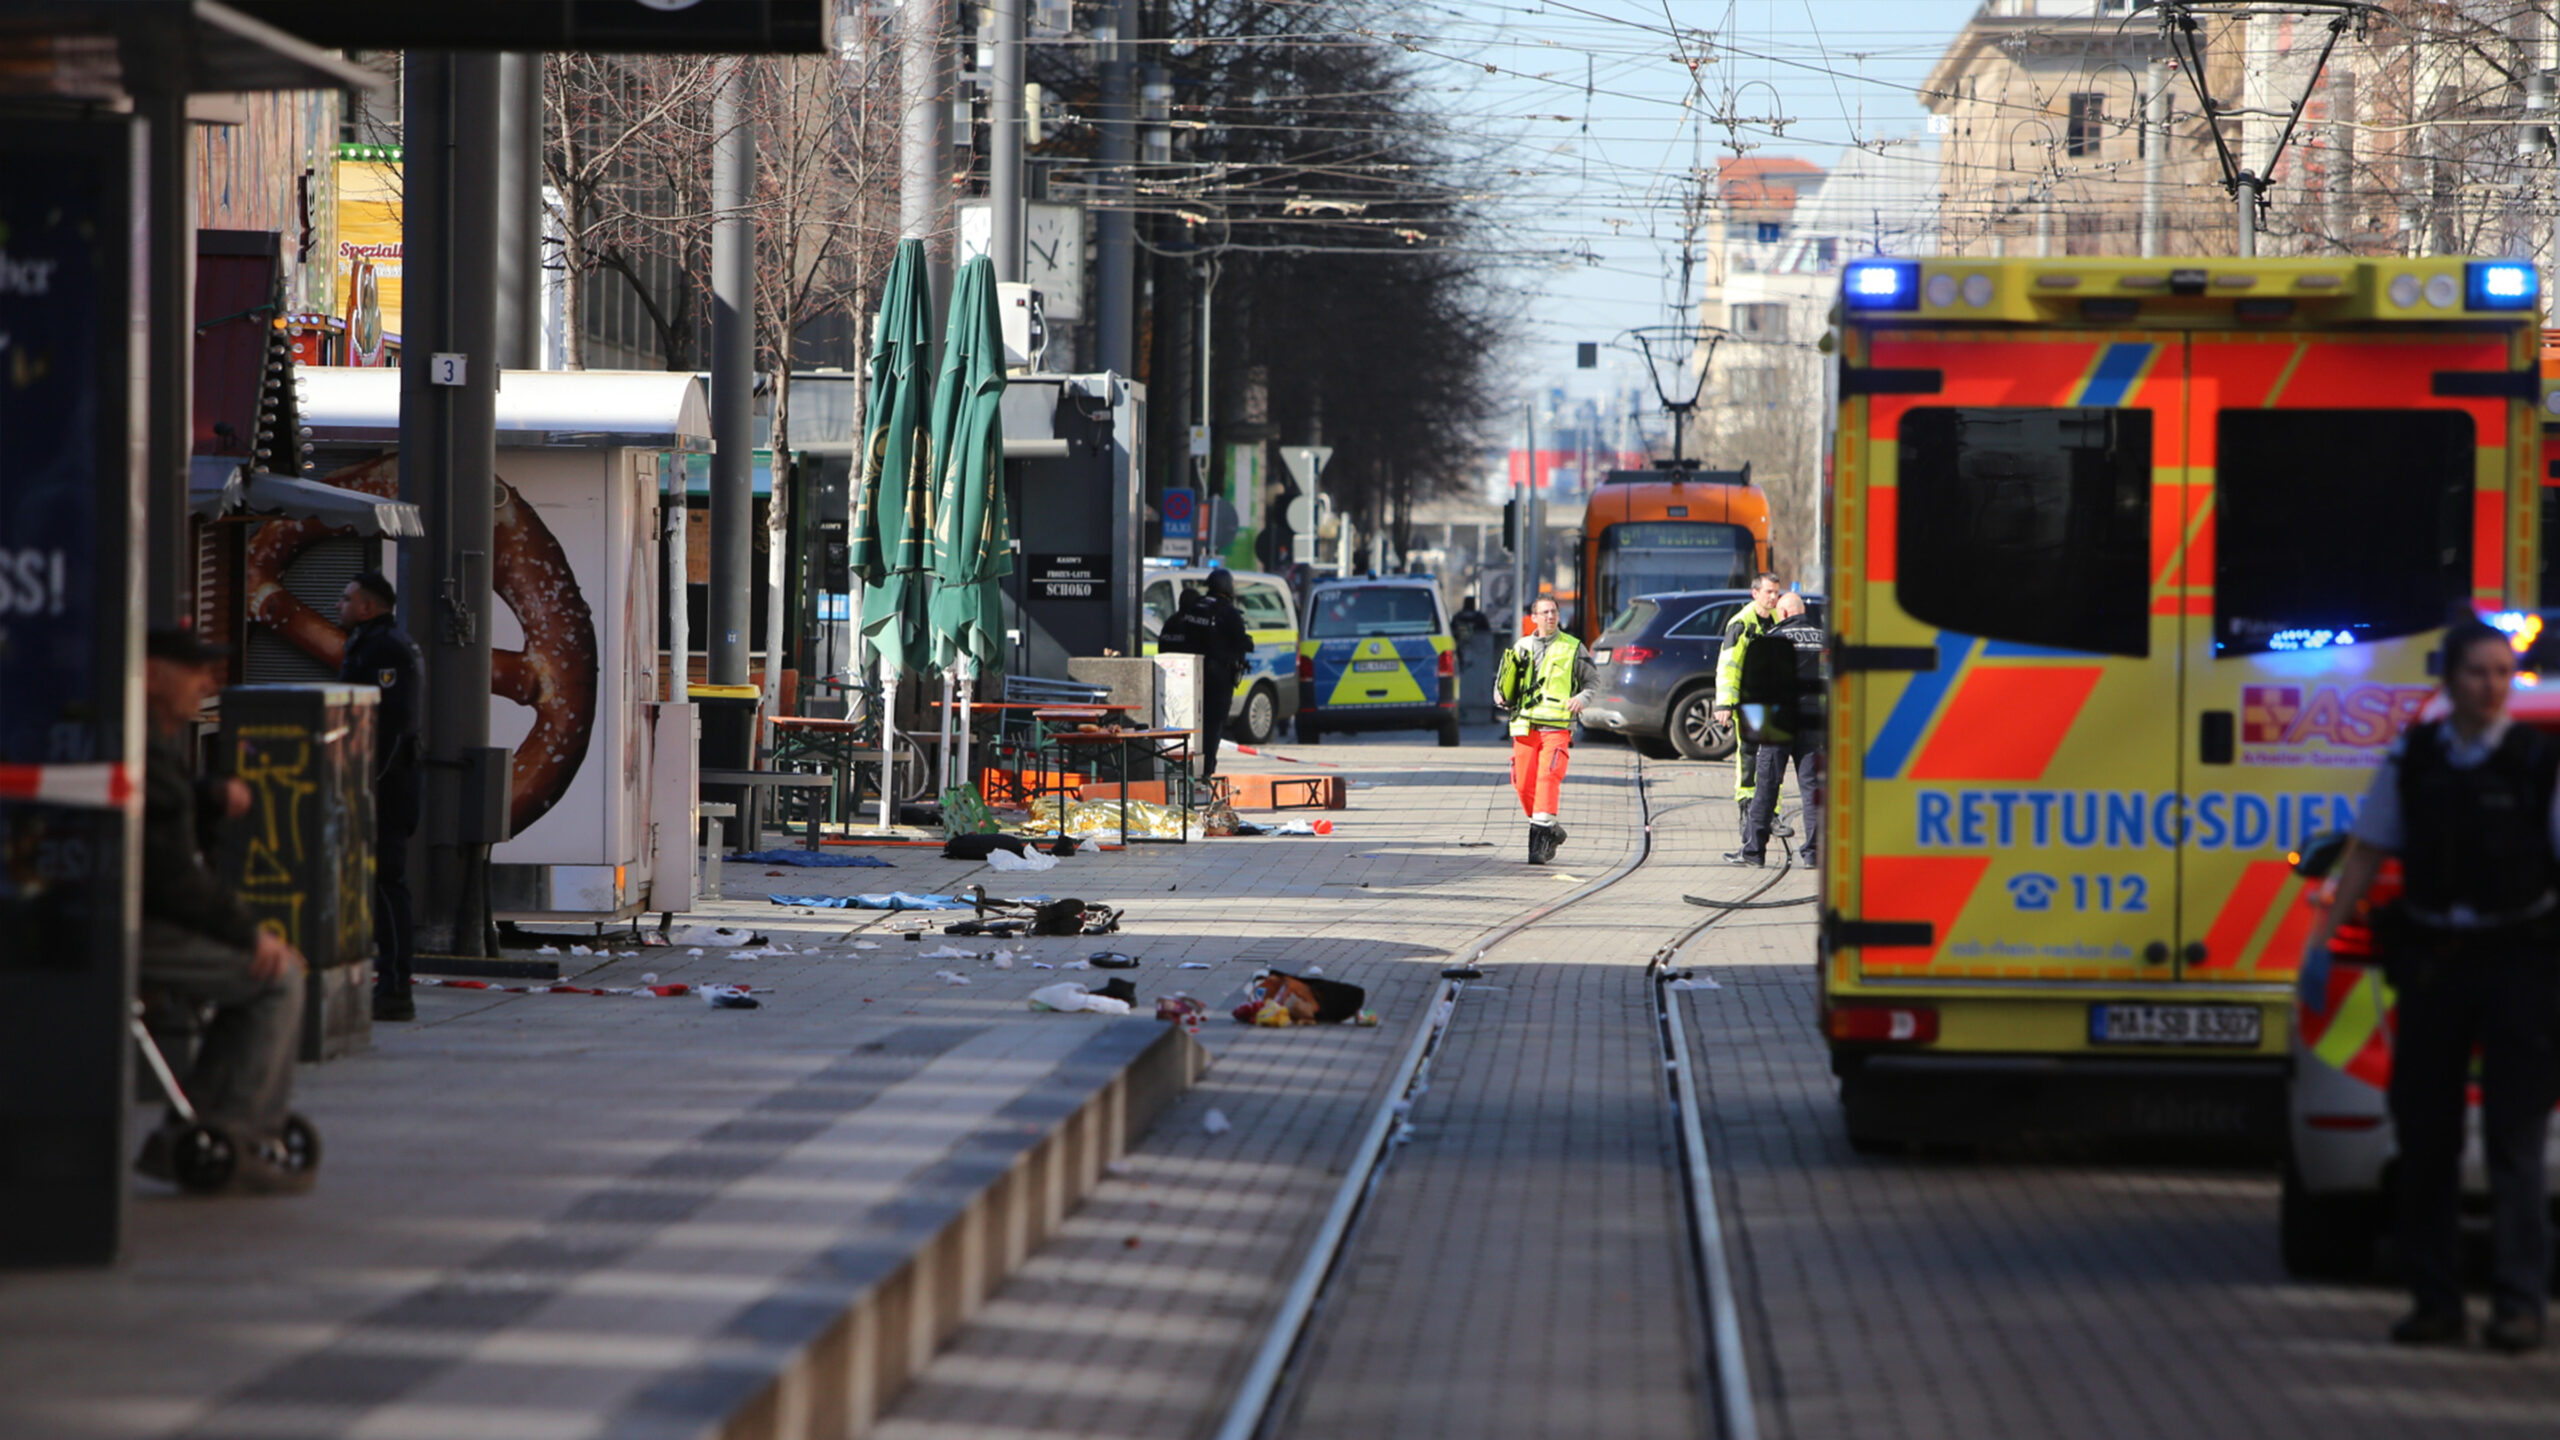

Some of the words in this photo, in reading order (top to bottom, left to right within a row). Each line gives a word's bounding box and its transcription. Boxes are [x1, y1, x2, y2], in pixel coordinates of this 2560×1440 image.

[444, 360, 454, 382] 3
[1164, 522, 1191, 533] TAXI
[1046, 583, 1092, 596] SCHOKO
[1184, 614, 1210, 626] POLIZEI
[1161, 634, 1185, 642] POLIZEI
[2070, 874, 2148, 912] 112
[2109, 1010, 2140, 1034] MA
